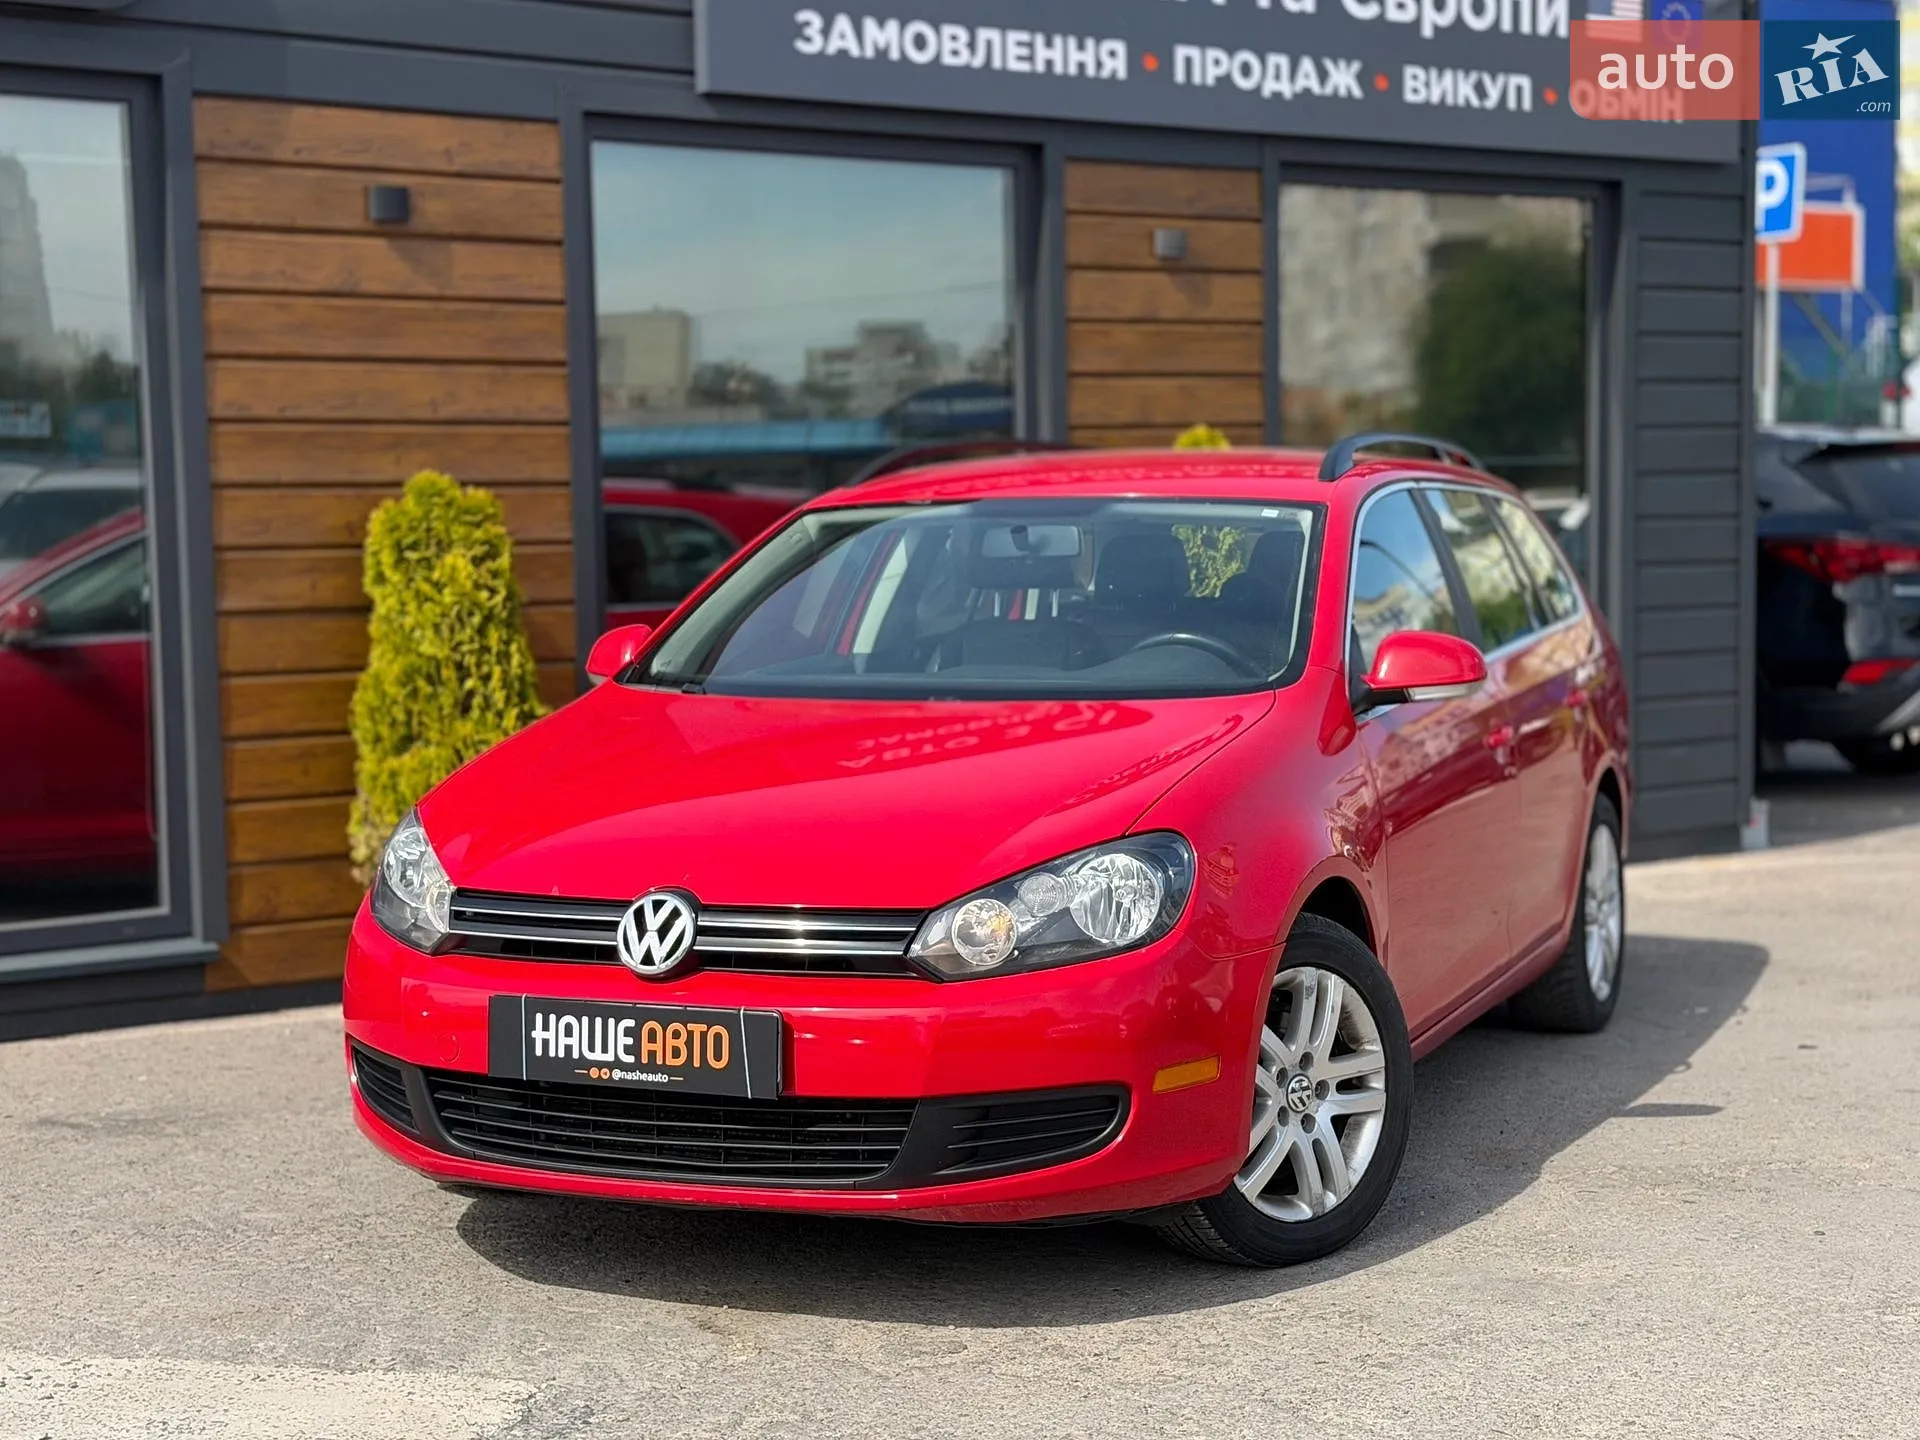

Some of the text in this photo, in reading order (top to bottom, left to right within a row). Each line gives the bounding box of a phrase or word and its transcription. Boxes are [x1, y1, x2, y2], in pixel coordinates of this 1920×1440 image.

[794, 10, 1127, 80] ЗАМОВЛЕННЯ
[1173, 44, 1364, 99] ПРОДАЖ
[1403, 64, 1533, 112] ВИКУП
[1756, 157, 1790, 231] P
[617, 893, 694, 974] VW
[531, 1013, 730, 1069] НАШЕ АВТО
[611, 1069, 669, 1083] @nasheauto
